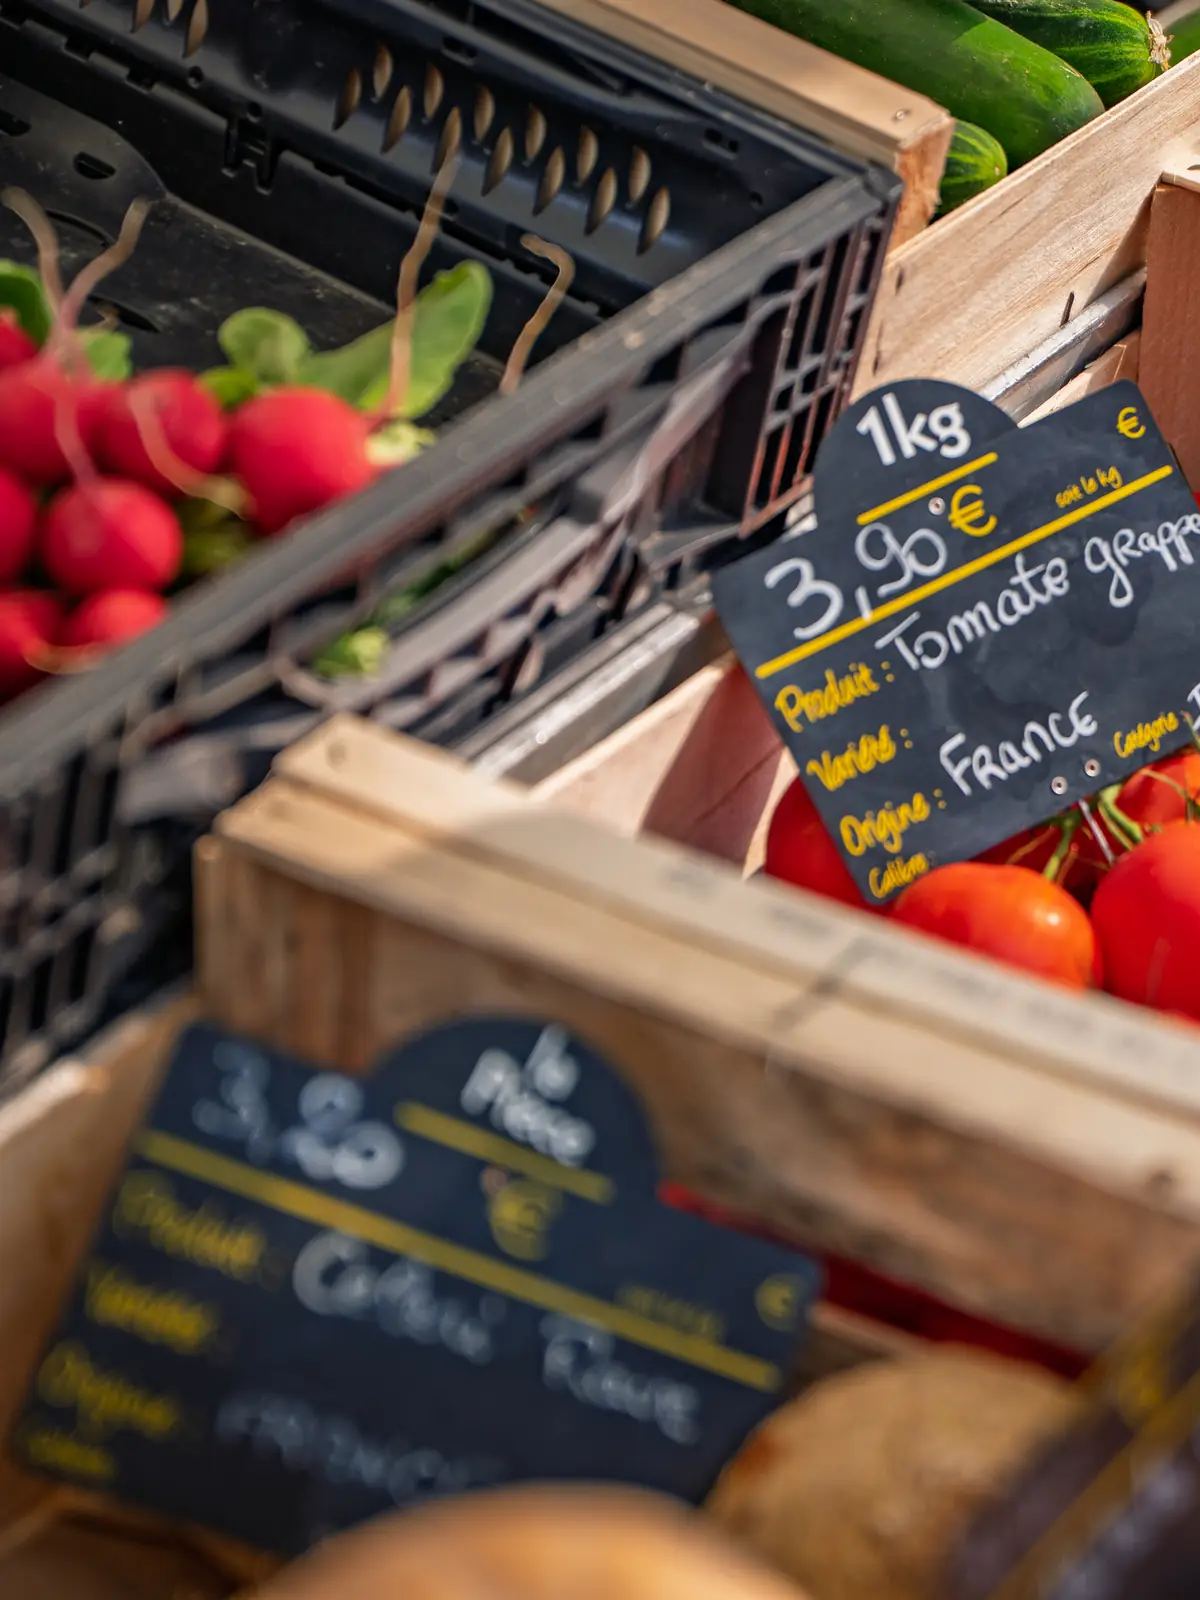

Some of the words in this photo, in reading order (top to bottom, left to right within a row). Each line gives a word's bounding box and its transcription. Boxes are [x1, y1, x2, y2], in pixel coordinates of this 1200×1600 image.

[856, 392, 972, 466] 1kg
[764, 522, 948, 640] 3,90
[874, 552, 1070, 670] Tomate
